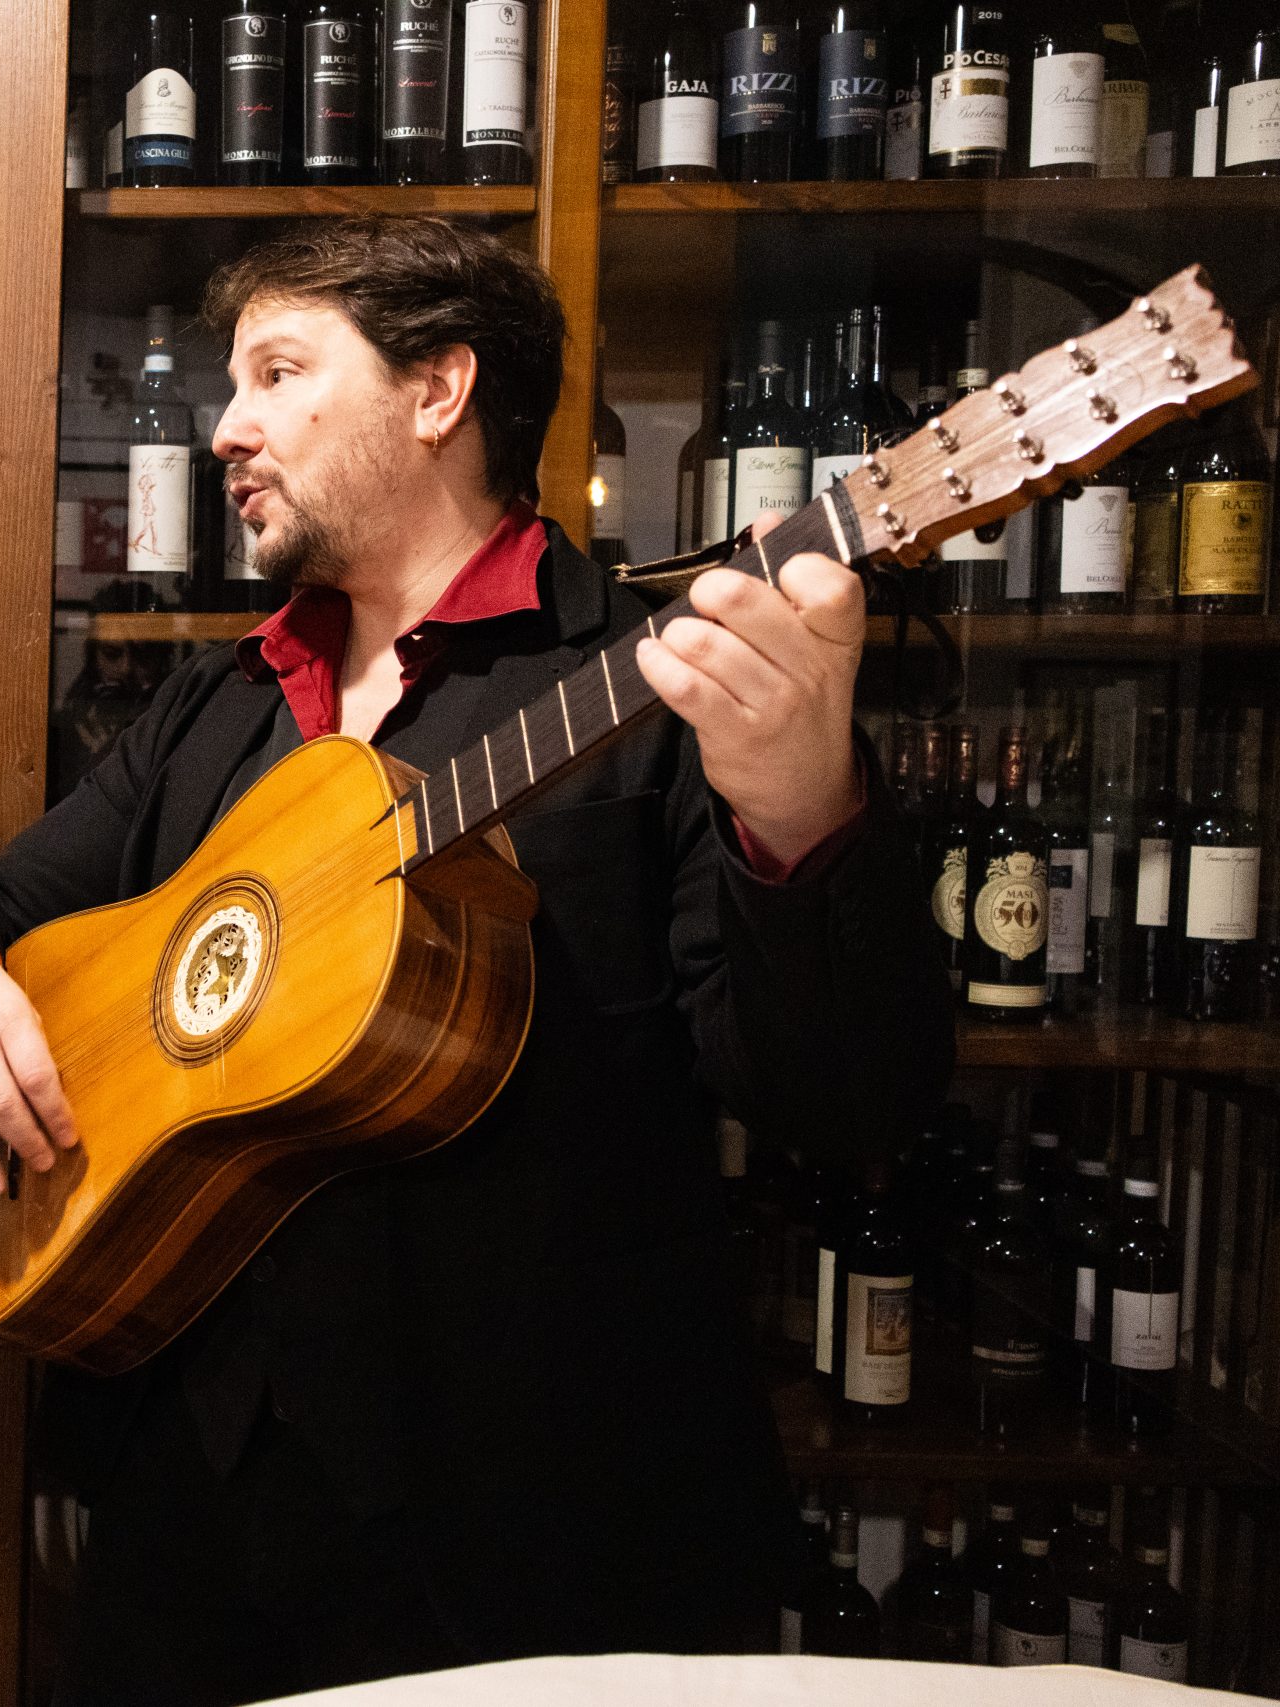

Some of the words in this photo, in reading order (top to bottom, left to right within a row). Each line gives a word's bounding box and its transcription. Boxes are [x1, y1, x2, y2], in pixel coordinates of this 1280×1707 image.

[977, 10, 1003, 20] 2019
[667, 79, 709, 94] GAJA
[759, 496, 801, 509] Barolo
[1006, 890, 1034, 900] MASI
